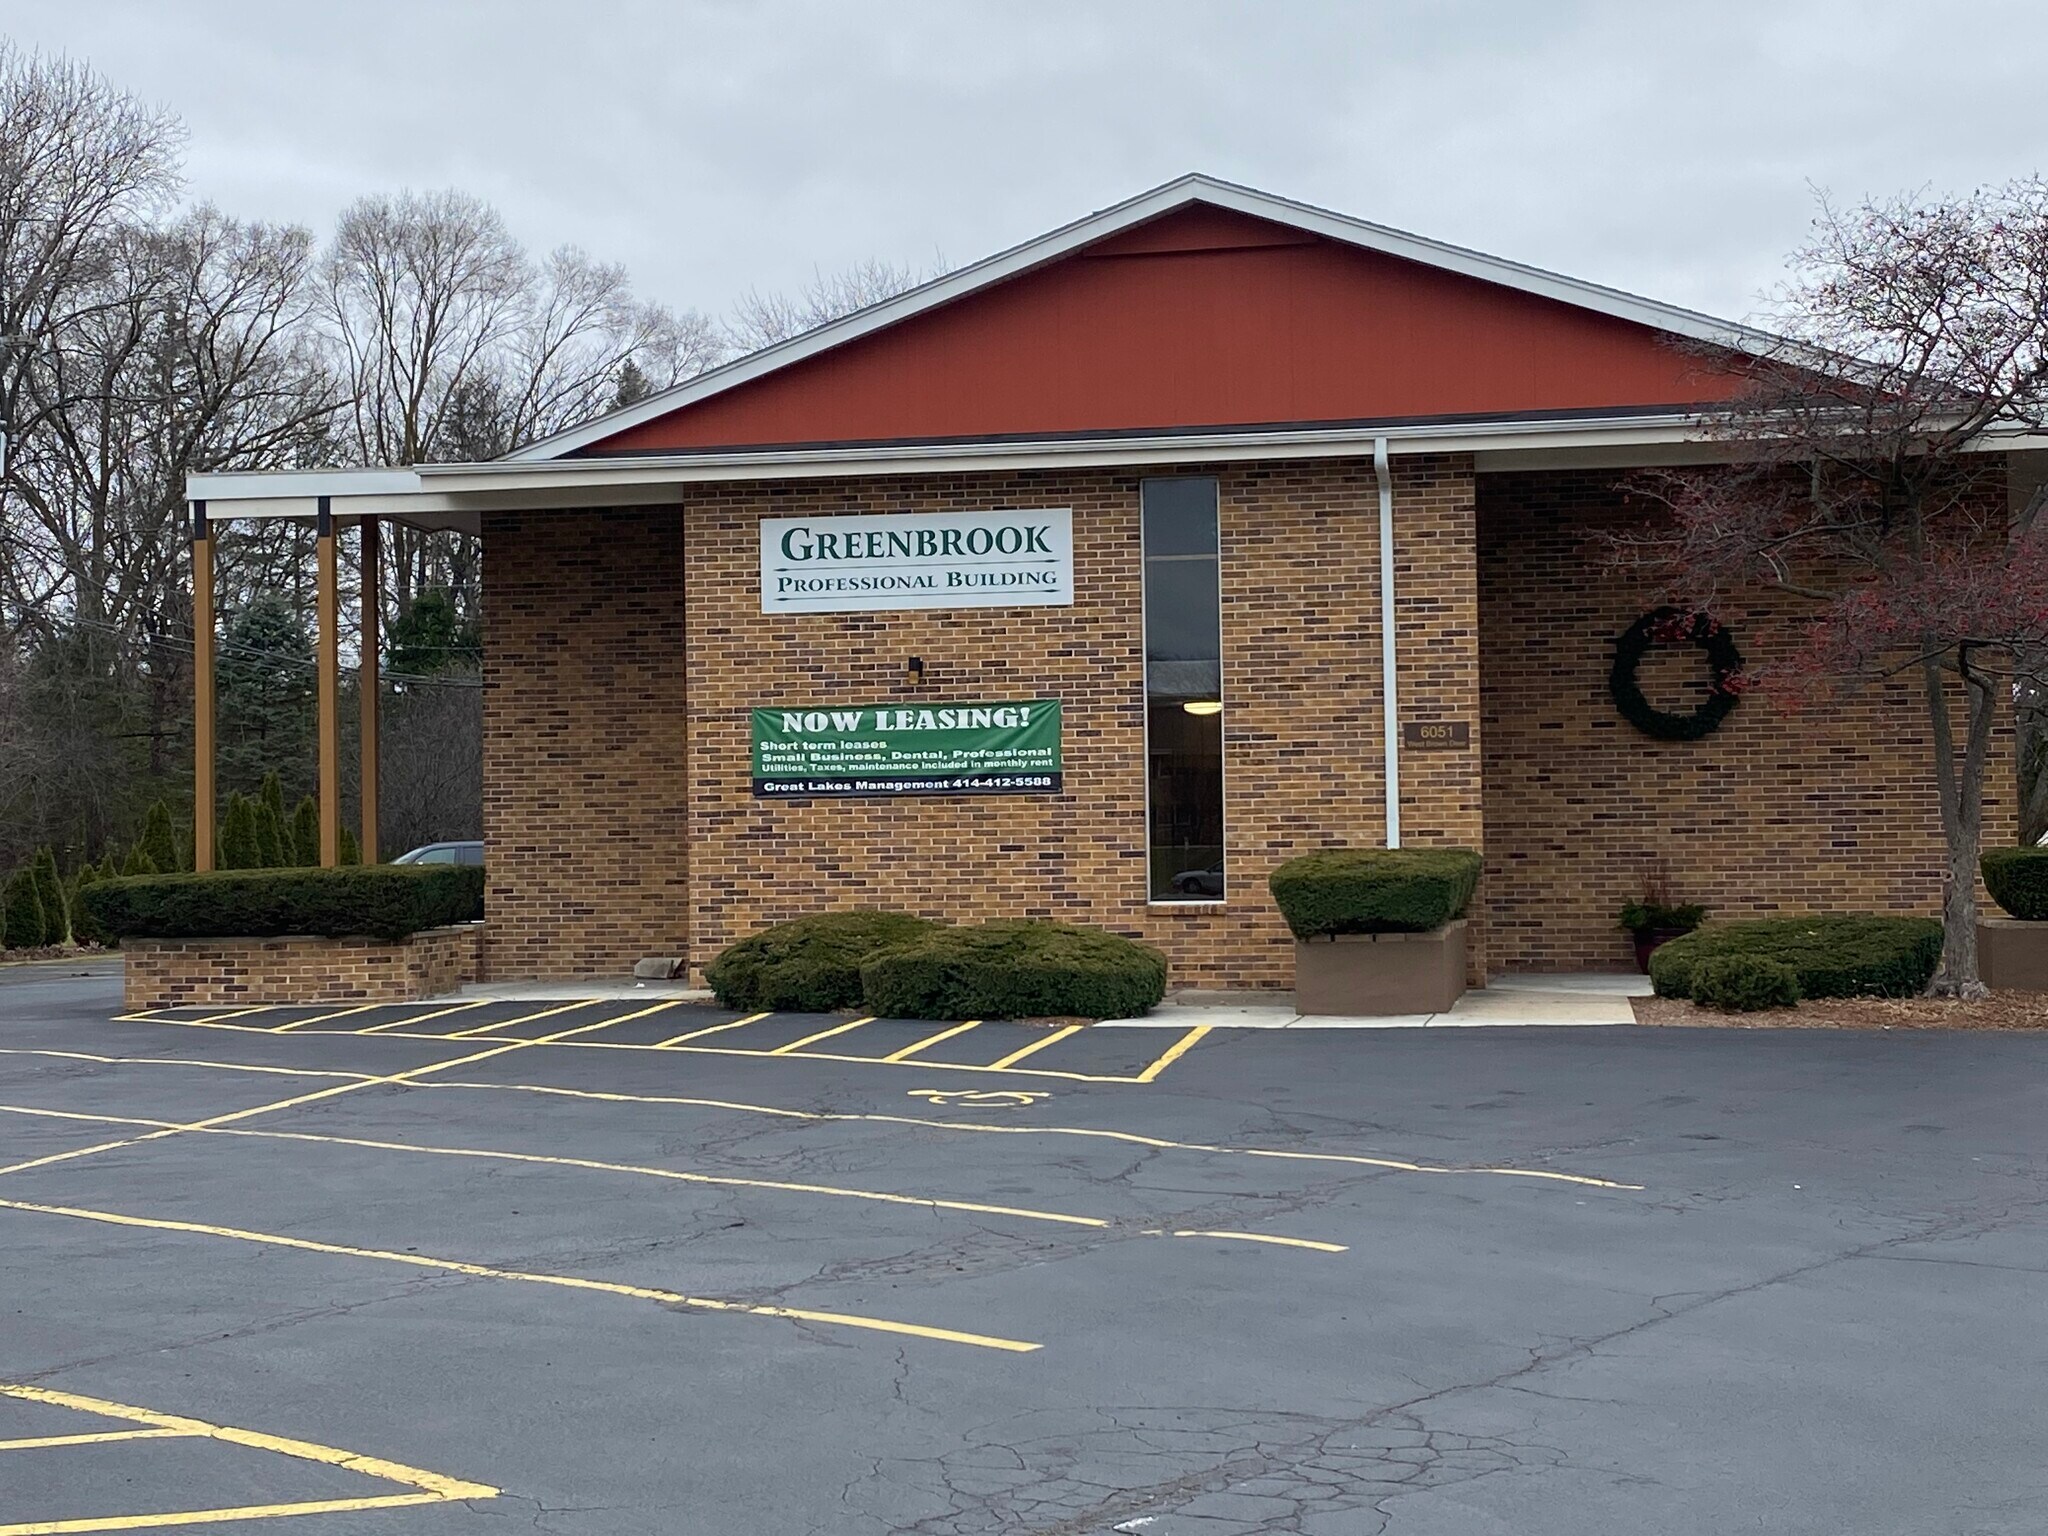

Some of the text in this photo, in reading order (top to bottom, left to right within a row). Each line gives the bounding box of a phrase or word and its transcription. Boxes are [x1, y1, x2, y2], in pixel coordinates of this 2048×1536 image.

[781, 526, 1053, 561] GREENBROOK
[777, 570, 1057, 593] PROFESSIONAL BUILDING
[782, 707, 1030, 732] NOW LEASING!
[1421, 726, 1453, 738] 6051
[760, 740, 888, 751] Short term leases
[762, 748, 1052, 762] Small Business, Dental, Professional
[762, 758, 1053, 772] Utilities, Taxes, maintenance included in monthly rent
[764, 782, 804, 791] Great
[808, 781, 852, 791] Lakes
[855, 780, 949, 791] Management
